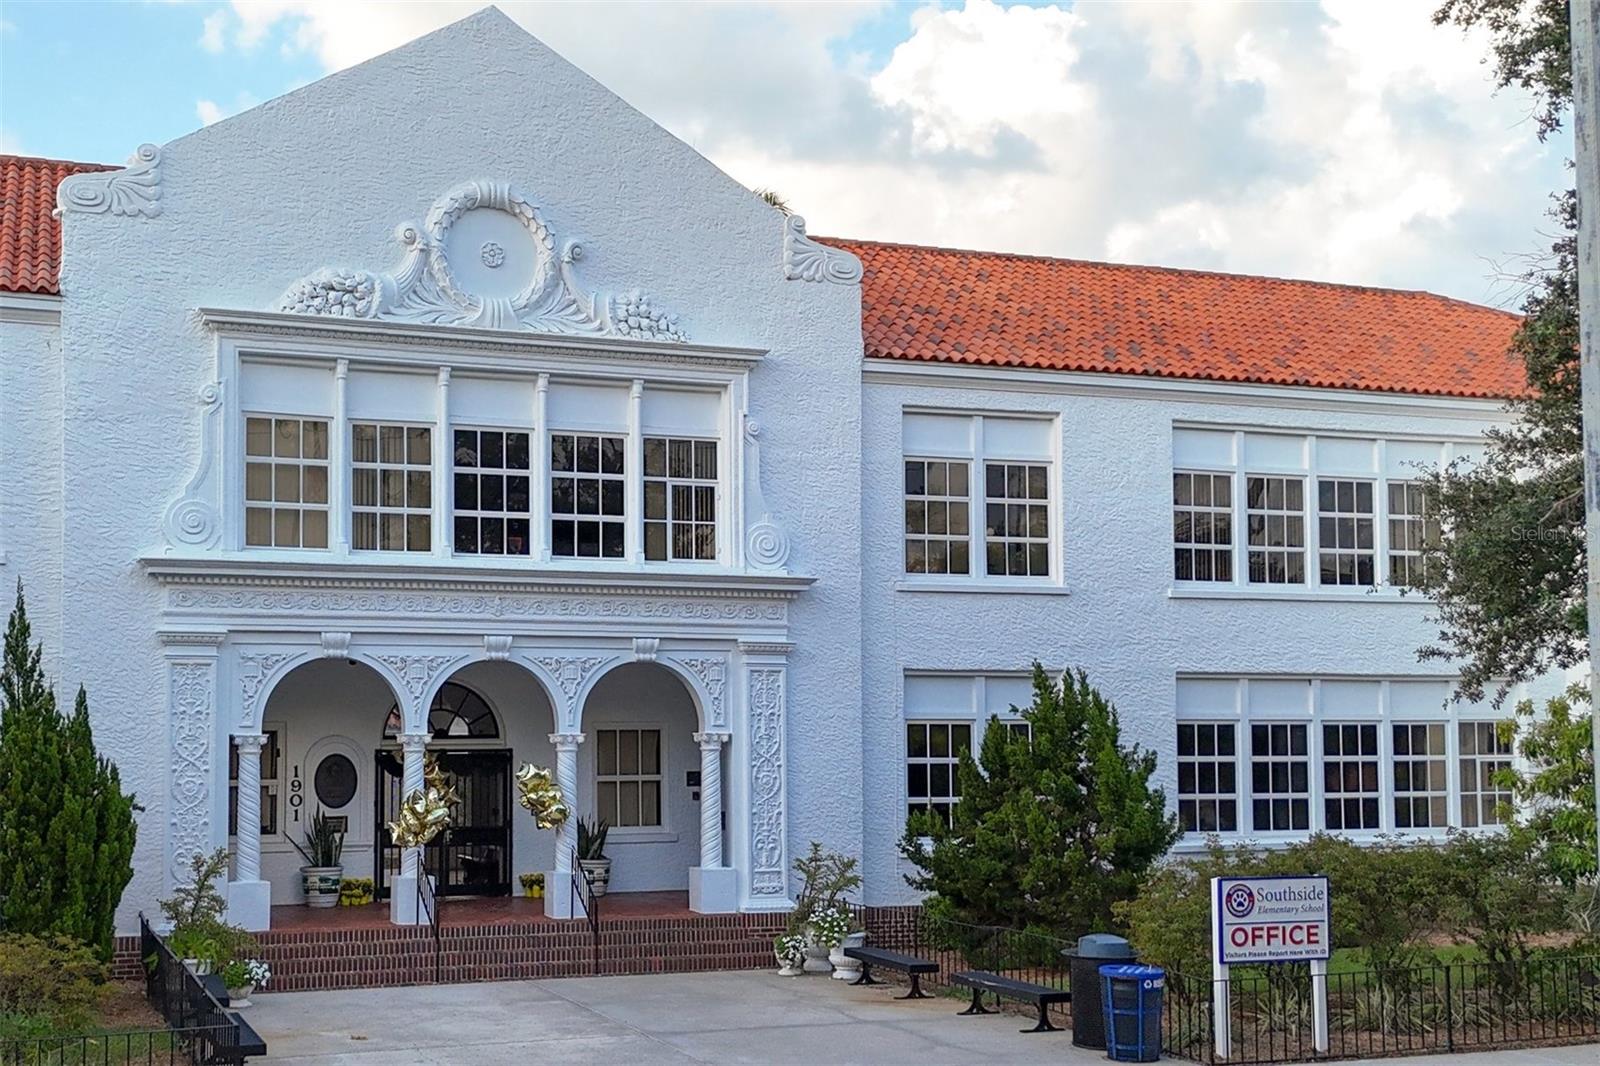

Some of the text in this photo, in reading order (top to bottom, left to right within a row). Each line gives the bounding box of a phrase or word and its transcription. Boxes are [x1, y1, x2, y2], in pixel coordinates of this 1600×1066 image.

[289, 765, 303, 822] 1901
[1256, 885, 1324, 902] Southside
[1257, 905, 1299, 915] Elementary
[1300, 903, 1325, 913] School
[1230, 924, 1320, 948] OFFICE
[1225, 950, 1247, 959] Visitors
[1248, 950, 1267, 958] Please
[1268, 949, 1288, 958] Report
[1289, 949, 1303, 957] Here
[1304, 948, 1318, 956] With
